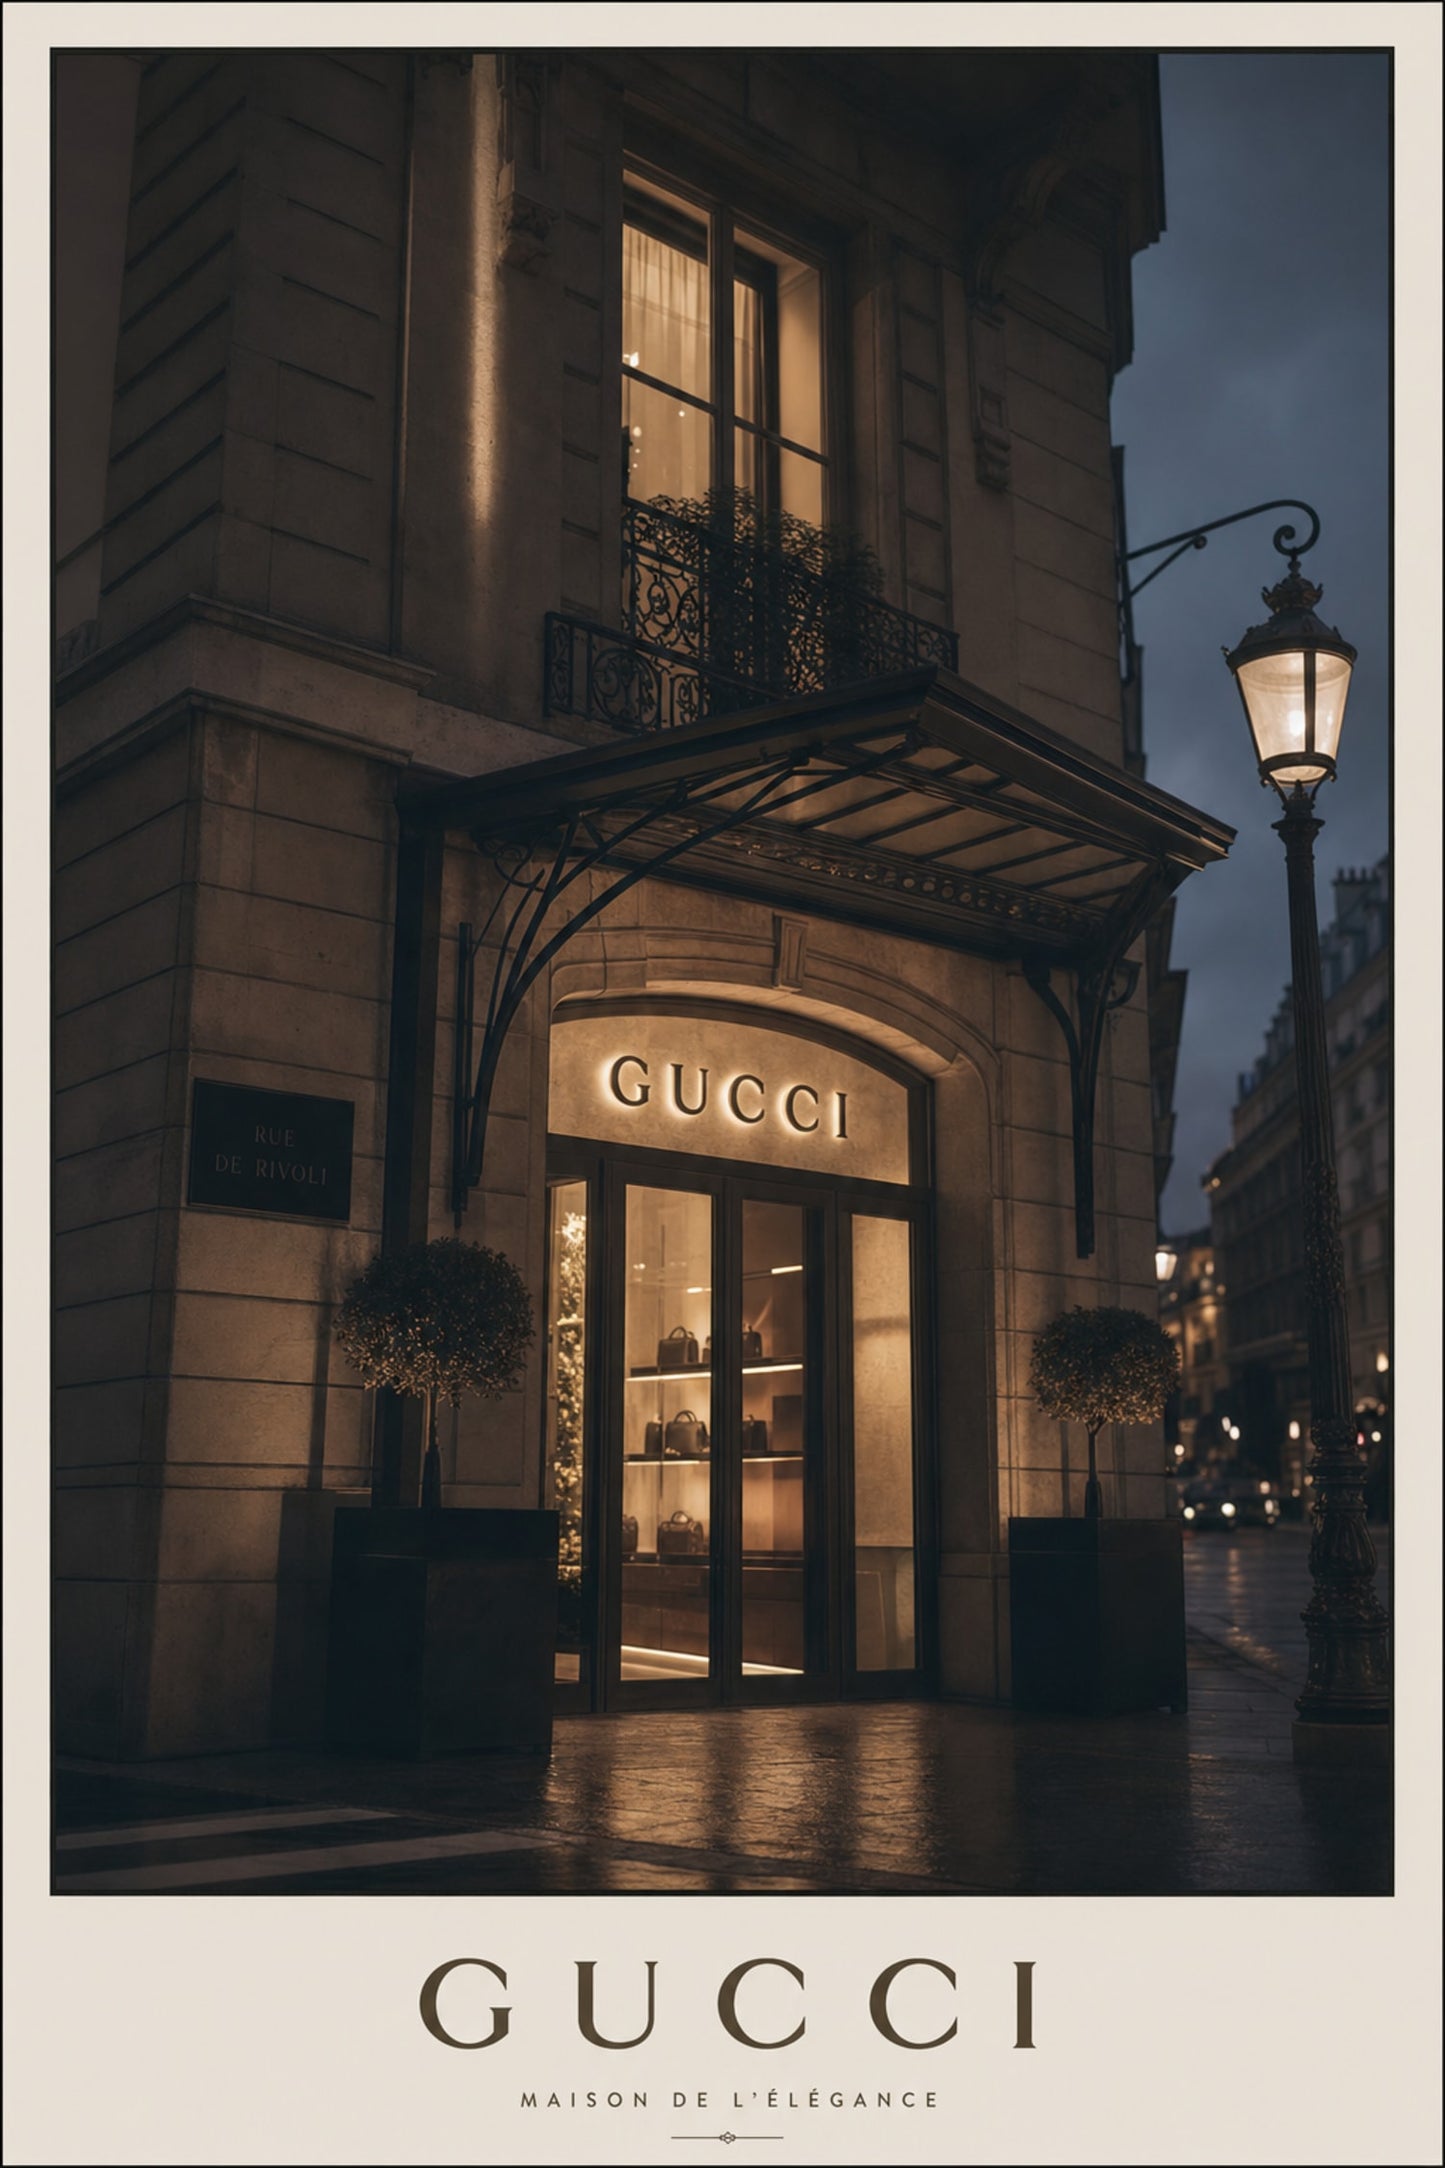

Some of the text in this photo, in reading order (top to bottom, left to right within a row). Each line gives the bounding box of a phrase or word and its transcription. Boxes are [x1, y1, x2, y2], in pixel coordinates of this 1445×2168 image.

[609, 1055, 848, 1139] GUCCI
[255, 1124, 295, 1147] RUE
[215, 1153, 327, 1185] DE RIVOLI
